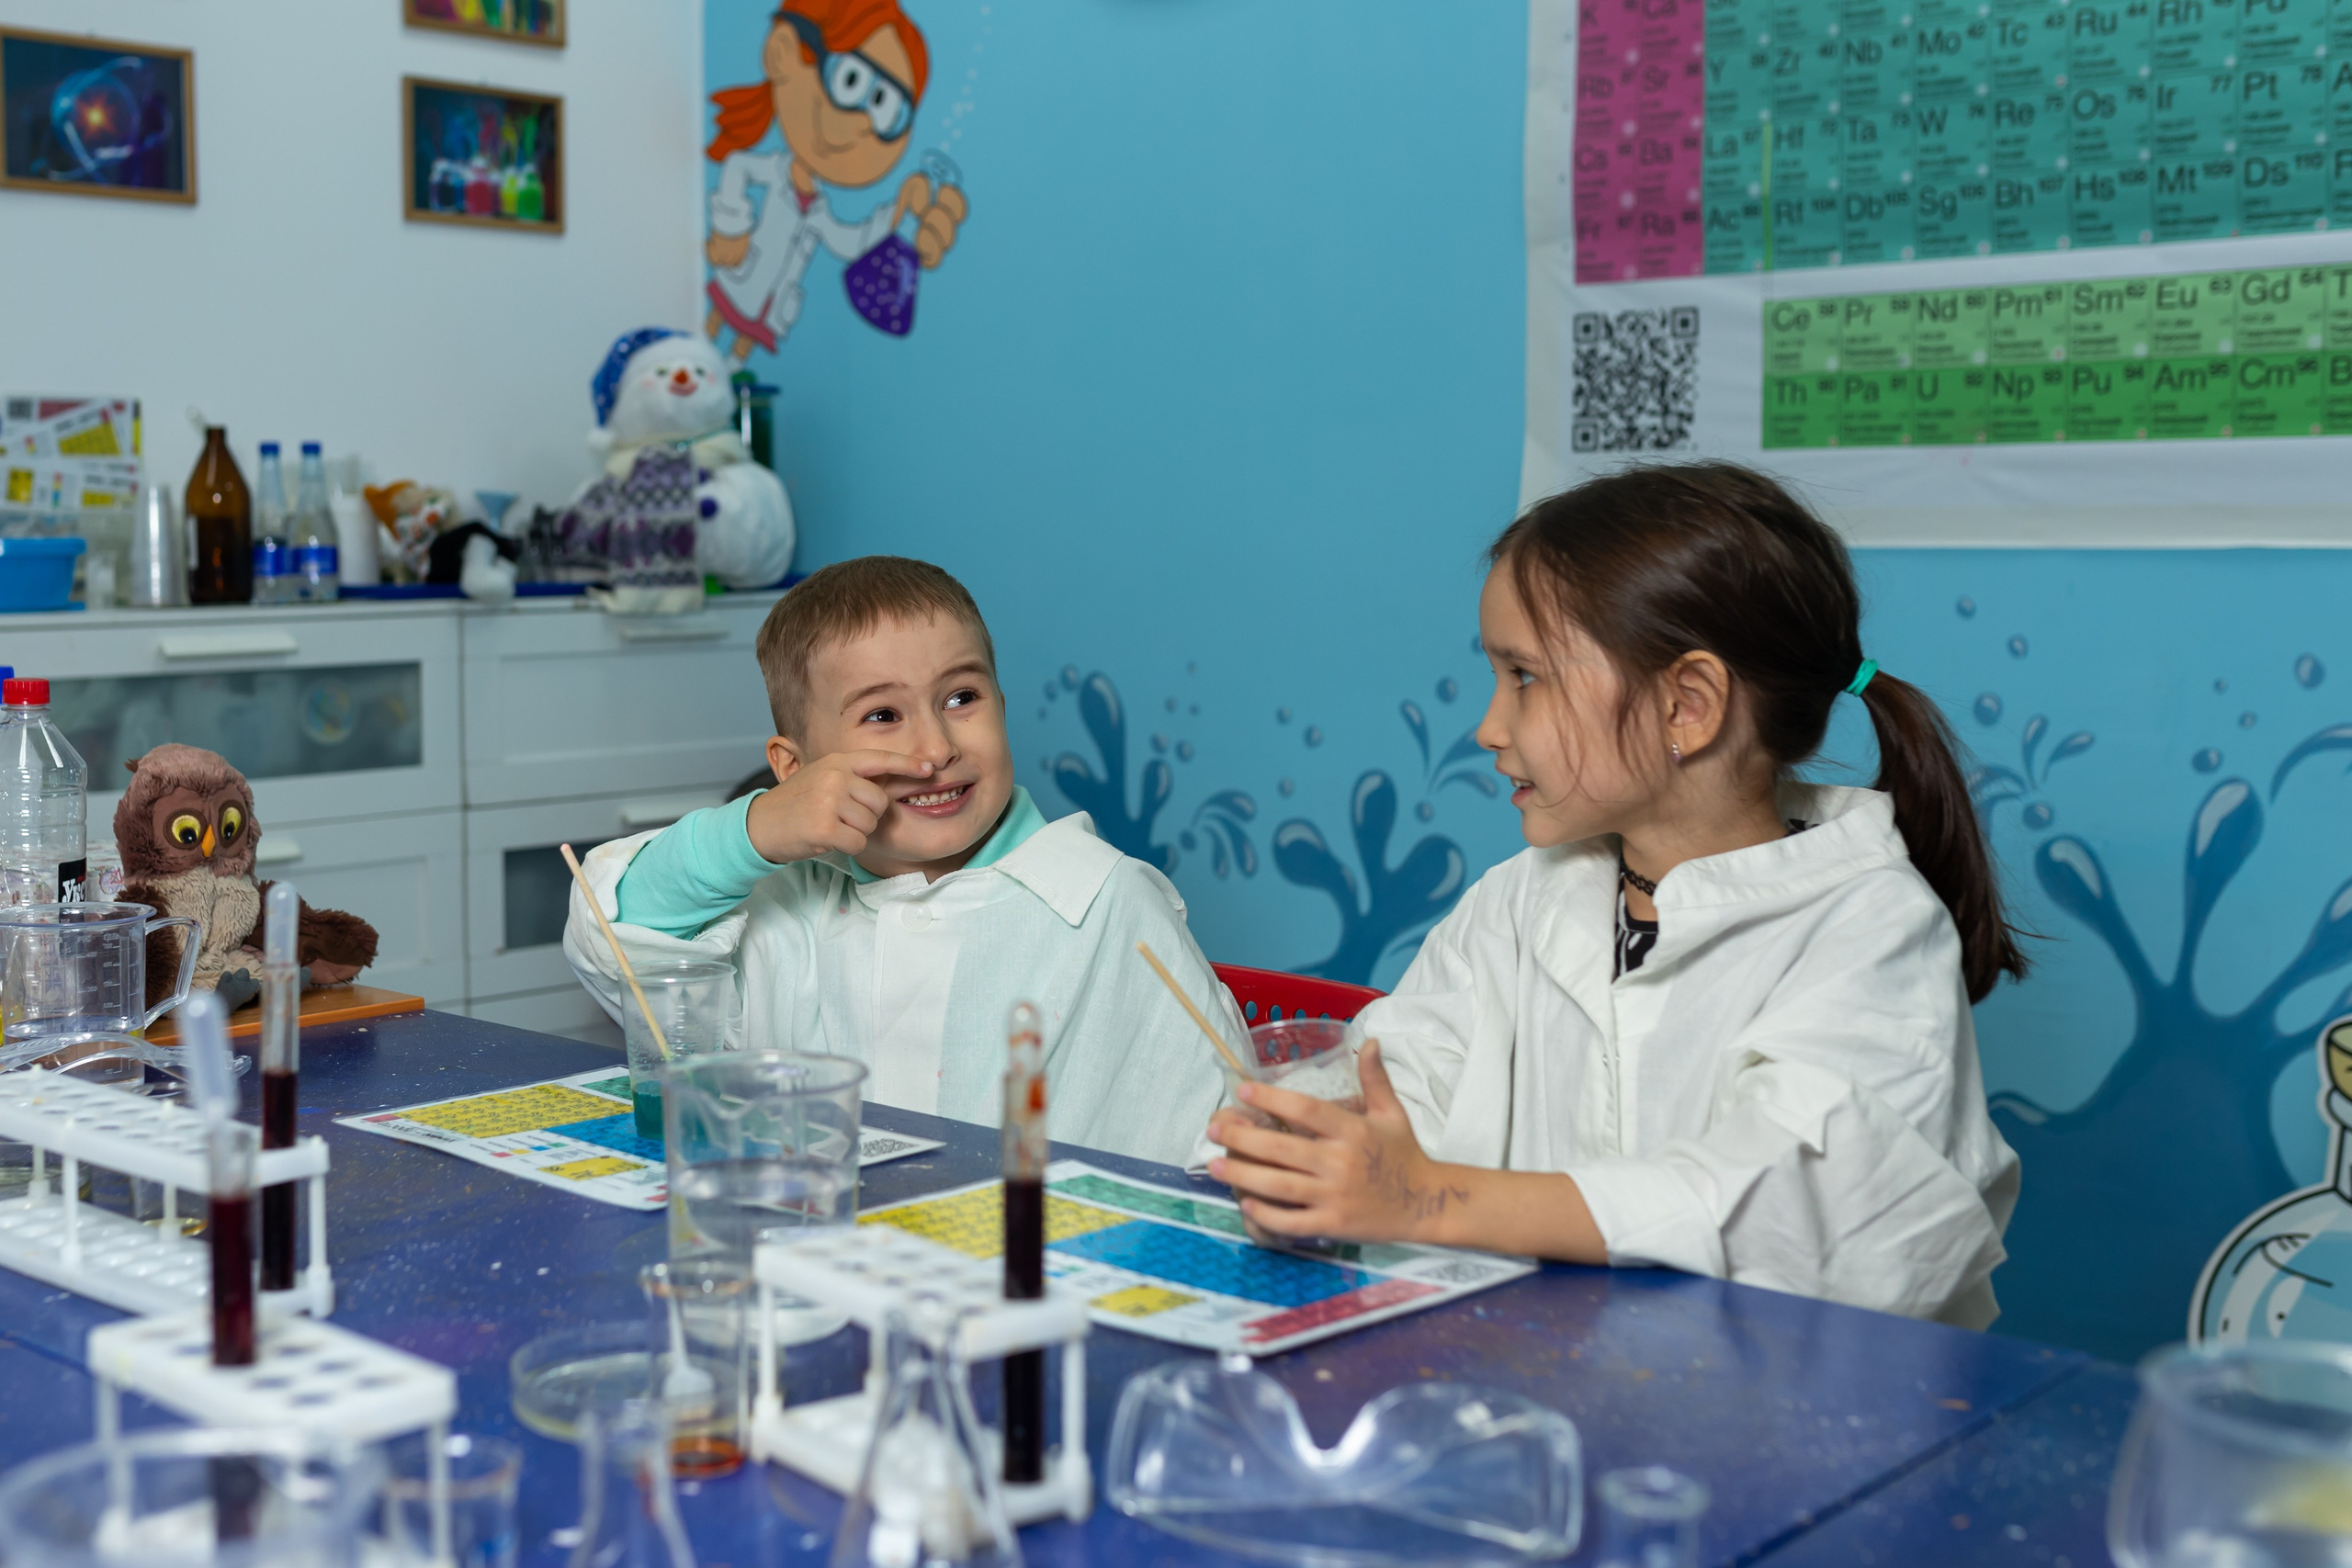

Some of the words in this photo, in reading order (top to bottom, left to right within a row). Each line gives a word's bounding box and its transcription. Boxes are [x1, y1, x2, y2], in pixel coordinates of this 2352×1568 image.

[1995, 18, 2030, 48] Tc
[2075, 7, 2119, 38] Ru
[1843, 39, 1883, 65] Nb
[1917, 28, 1962, 56] Mo
[2074, 89, 2117, 121] Os
[1847, 114, 1878, 144] Ta
[1917, 107, 1949, 136] W
[2245, 156, 2291, 189] Ds
[1845, 191, 1885, 222] Db
[1918, 185, 1958, 222] Sg
[1994, 288, 2042, 318] Pm
[2073, 282, 2125, 315] Sm
[2155, 277, 2199, 310] Eu
[2241, 273, 2292, 306] Gd
[1844, 297, 1874, 327] Pr
[1917, 293, 1959, 323] Nd
[1843, 373, 1881, 404] Pa
[1917, 372, 1940, 402] U
[1992, 369, 2036, 403] Np
[2071, 366, 2112, 397] Pu
[2153, 363, 2208, 393] Am
[2238, 358, 2297, 389] Cm
